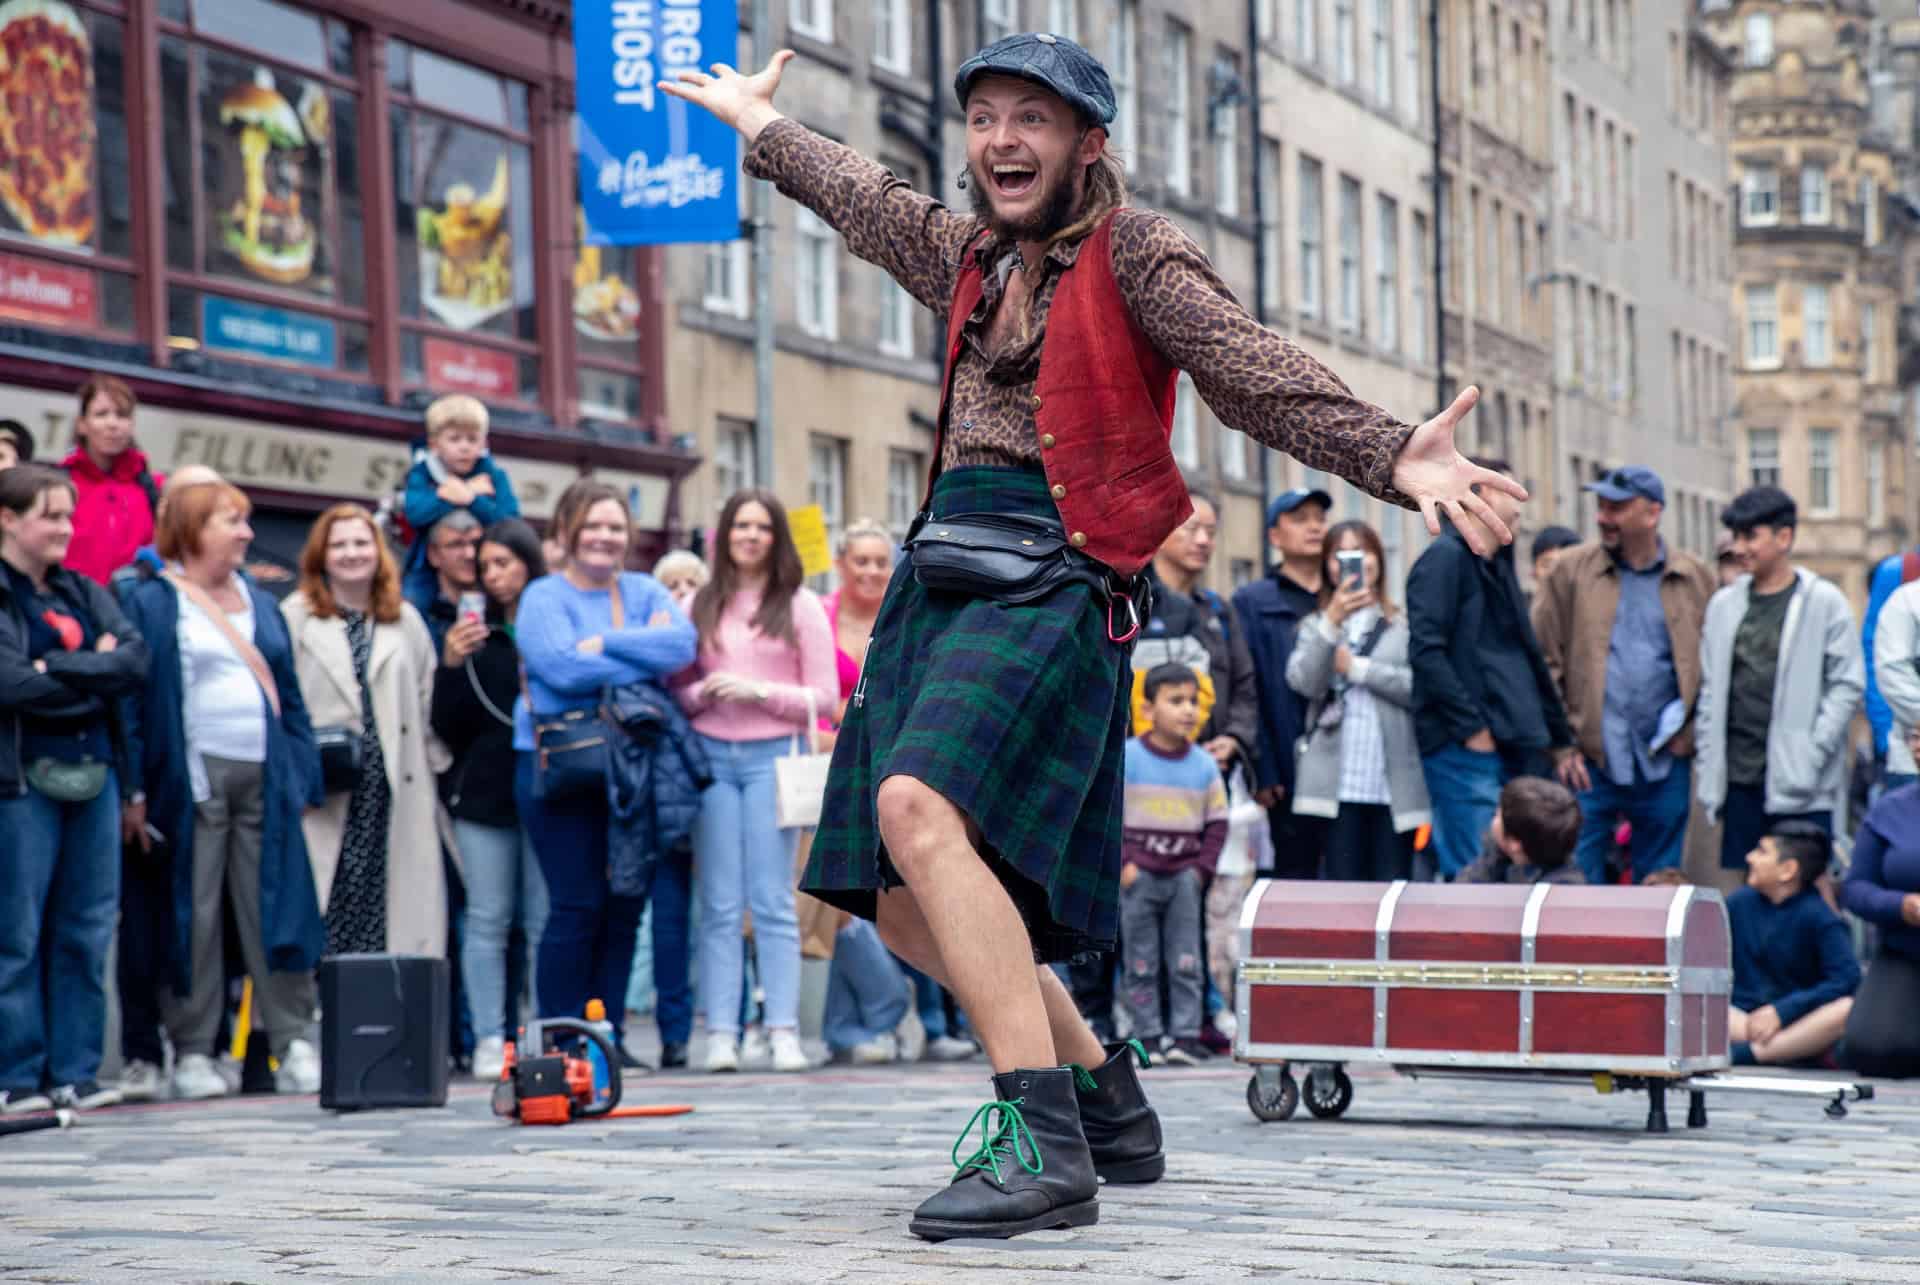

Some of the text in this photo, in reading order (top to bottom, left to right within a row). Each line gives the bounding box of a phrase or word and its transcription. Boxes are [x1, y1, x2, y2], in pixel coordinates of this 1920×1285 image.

[612, 0, 654, 111] HOST
[661, 0, 701, 88] RG
[173, 429, 332, 483] FILLING
